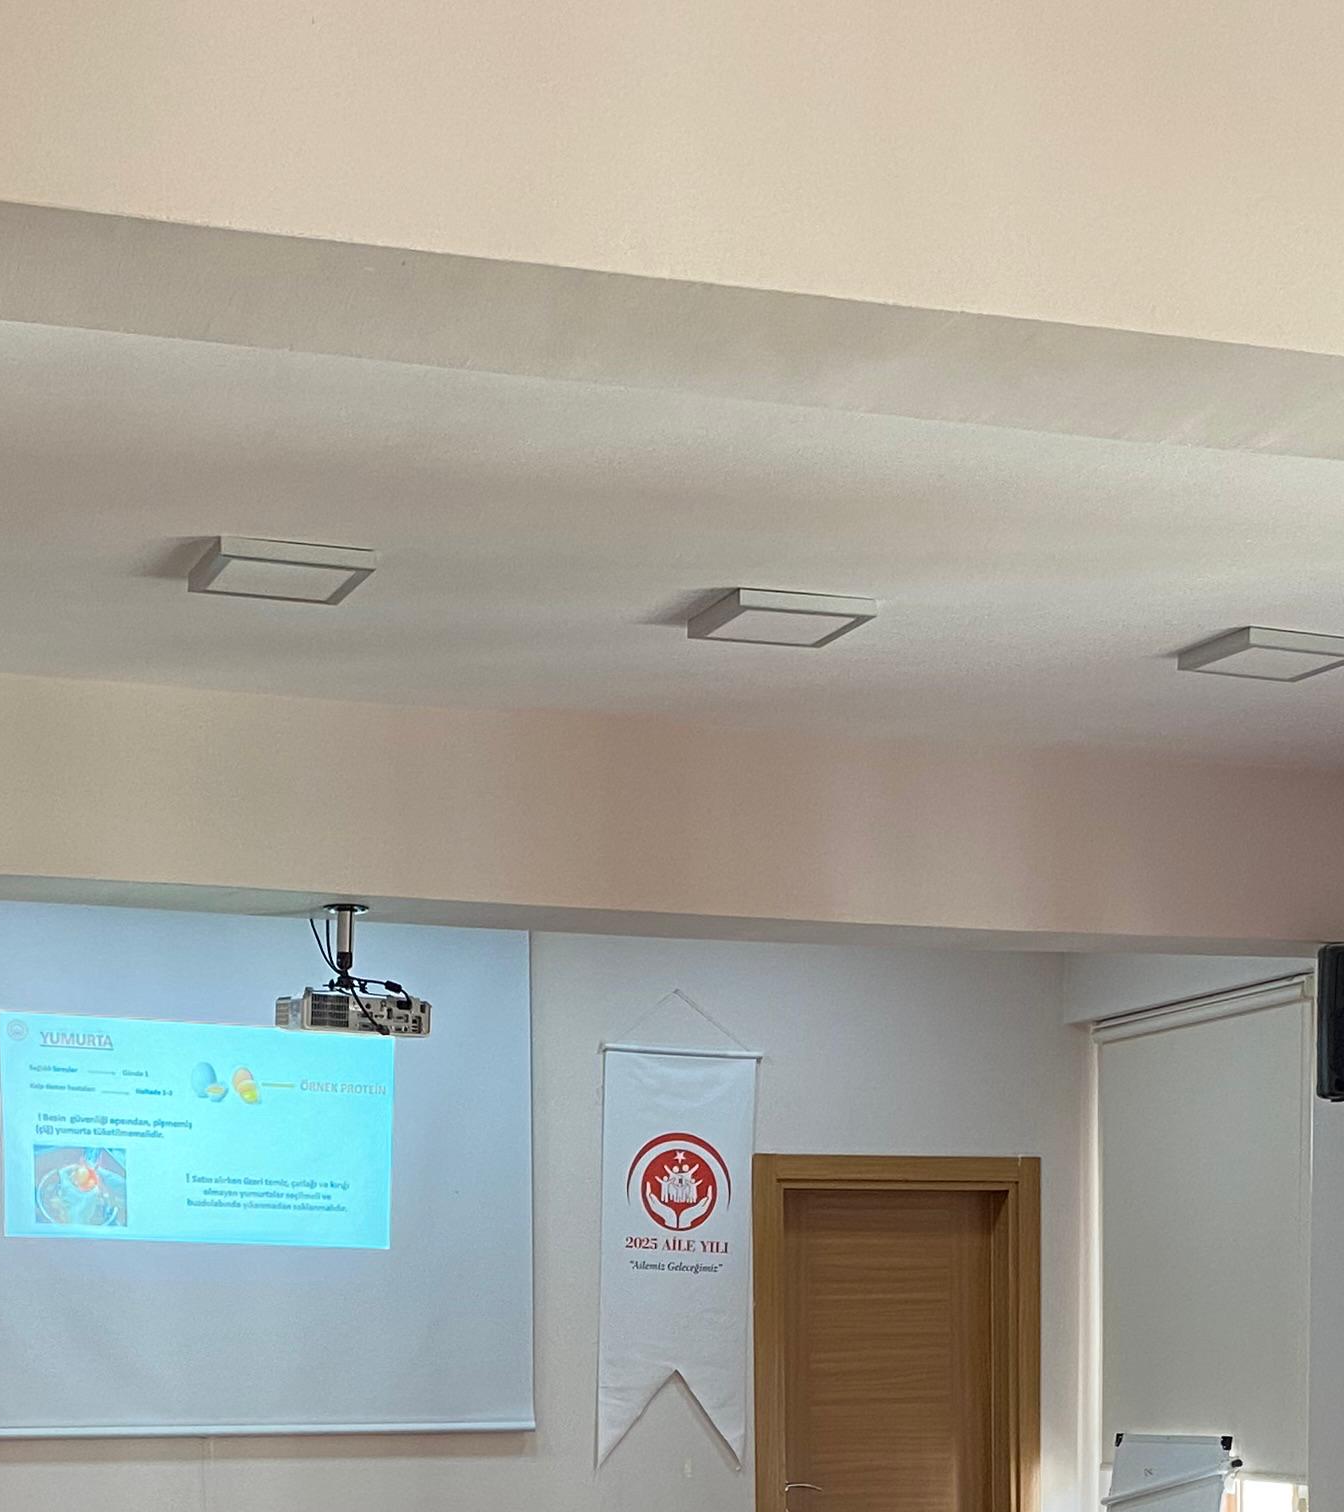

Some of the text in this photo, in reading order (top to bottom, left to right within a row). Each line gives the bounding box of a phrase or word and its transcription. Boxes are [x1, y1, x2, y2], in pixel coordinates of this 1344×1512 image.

[40, 1031, 114, 1048] YUMURTA
[300, 1079, 386, 1095] ÖRNEK PROTEİN
[43, 1113, 66, 1122] Besin
[55, 1126, 91, 1136] yumurta
[239, 1189, 285, 1199] yumurtalar
[625, 1236, 729, 1254] 2025 AİLE YILI
